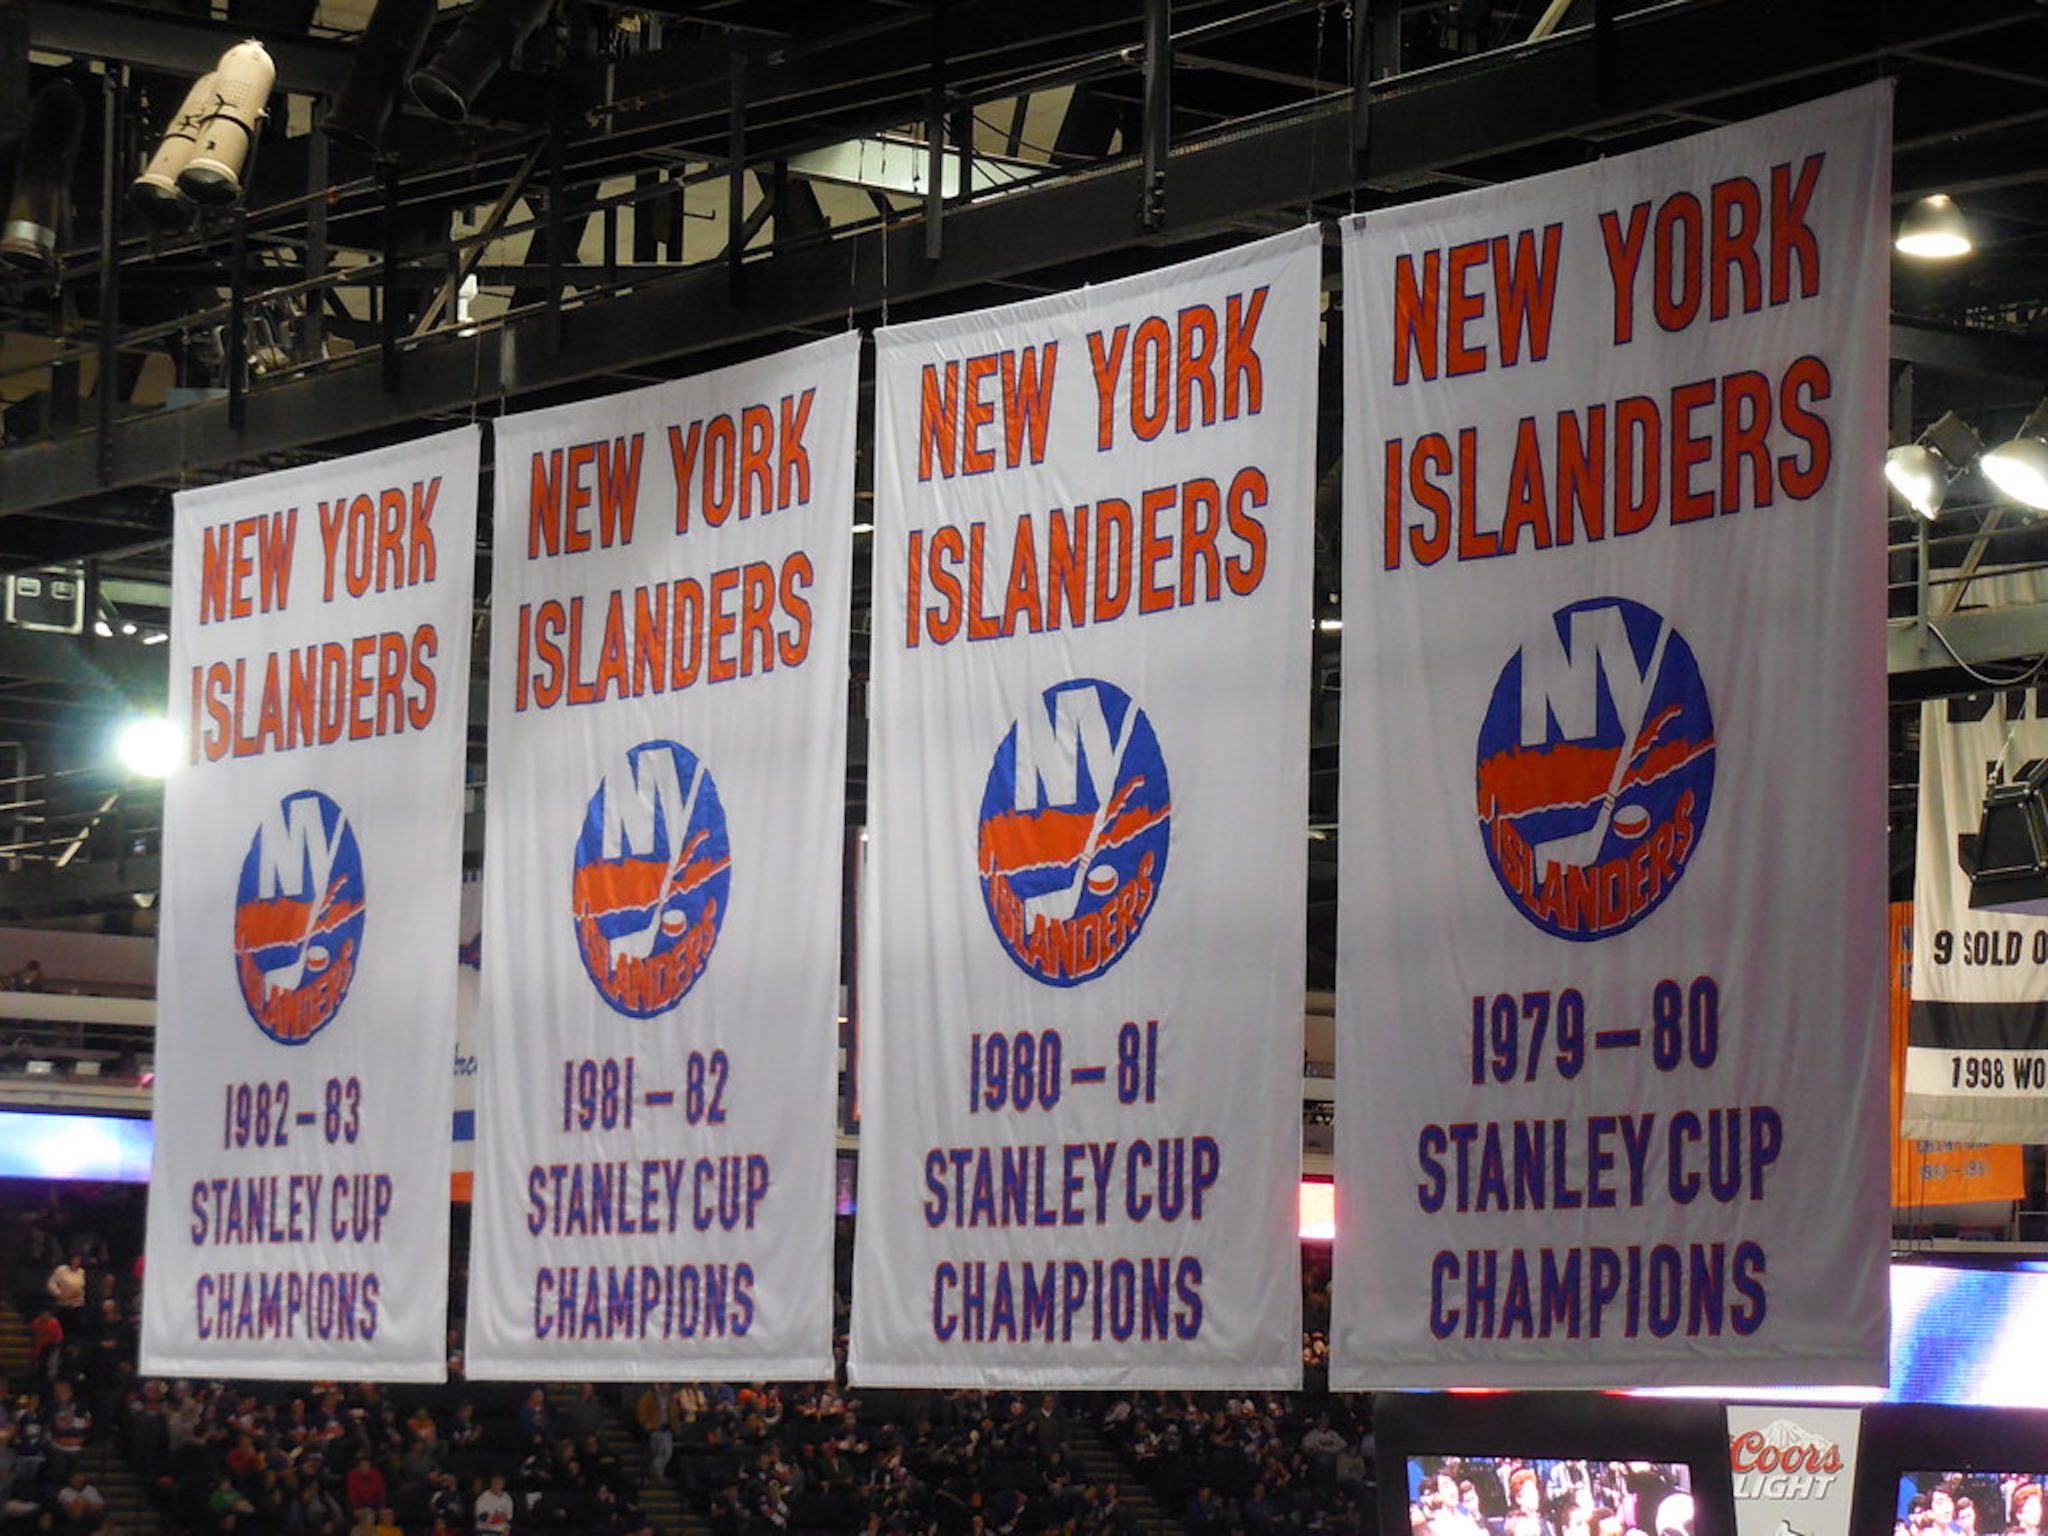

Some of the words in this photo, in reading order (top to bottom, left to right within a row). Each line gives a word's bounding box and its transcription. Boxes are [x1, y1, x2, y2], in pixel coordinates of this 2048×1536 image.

[1393, 222, 1564, 388] NEW
[1598, 154, 1825, 347] YORK
[917, 341, 1059, 482] NEW
[1087, 286, 1270, 452] YORK
[527, 432, 646, 561] NEW
[667, 388, 816, 536] YORK
[1383, 354, 1834, 573] ISLANDERS
[199, 509, 299, 623] NEW
[318, 477, 442, 604] YORK
[905, 466, 1270, 648] ISLANDERS
[514, 551, 815, 713] ISLANDERS
[1520, 604, 1672, 750] NY
[192, 623, 440, 760] ISLANDERS
[601, 746, 706, 862] NY
[1015, 684, 1140, 813] NY
[257, 797, 347, 902] NY
[1491, 789, 1695, 931] ISLANDERS
[989, 851, 1155, 978] ISLANDERS
[1933, 929, 1953, 966] 9
[1962, 929, 2023, 966] SOLD
[2032, 929, 2048, 966] O
[1951, 1057, 2004, 1088] 1998
[191, 1174, 320, 1245] STANLEY
[330, 1173, 392, 1243] CUP
[527, 1159, 685, 1236] STANLEY
[692, 1152, 769, 1233] CUP
[925, 1140, 1118, 1229] STANLEY
[1125, 1135, 1219, 1223] CUP
[1418, 1113, 1655, 1214] STANLEY
[1668, 1105, 1783, 1205] CUP
[197, 1270, 377, 1340] CHAMPIONS
[535, 1262, 755, 1340] CHAMPIONS
[933, 1255, 1203, 1344] CHAMPIONS
[1430, 1239, 1766, 1340] CHAMPIONS
[1730, 1430, 1844, 1474] Coors
[1733, 1475, 1837, 1501] LIGHT
